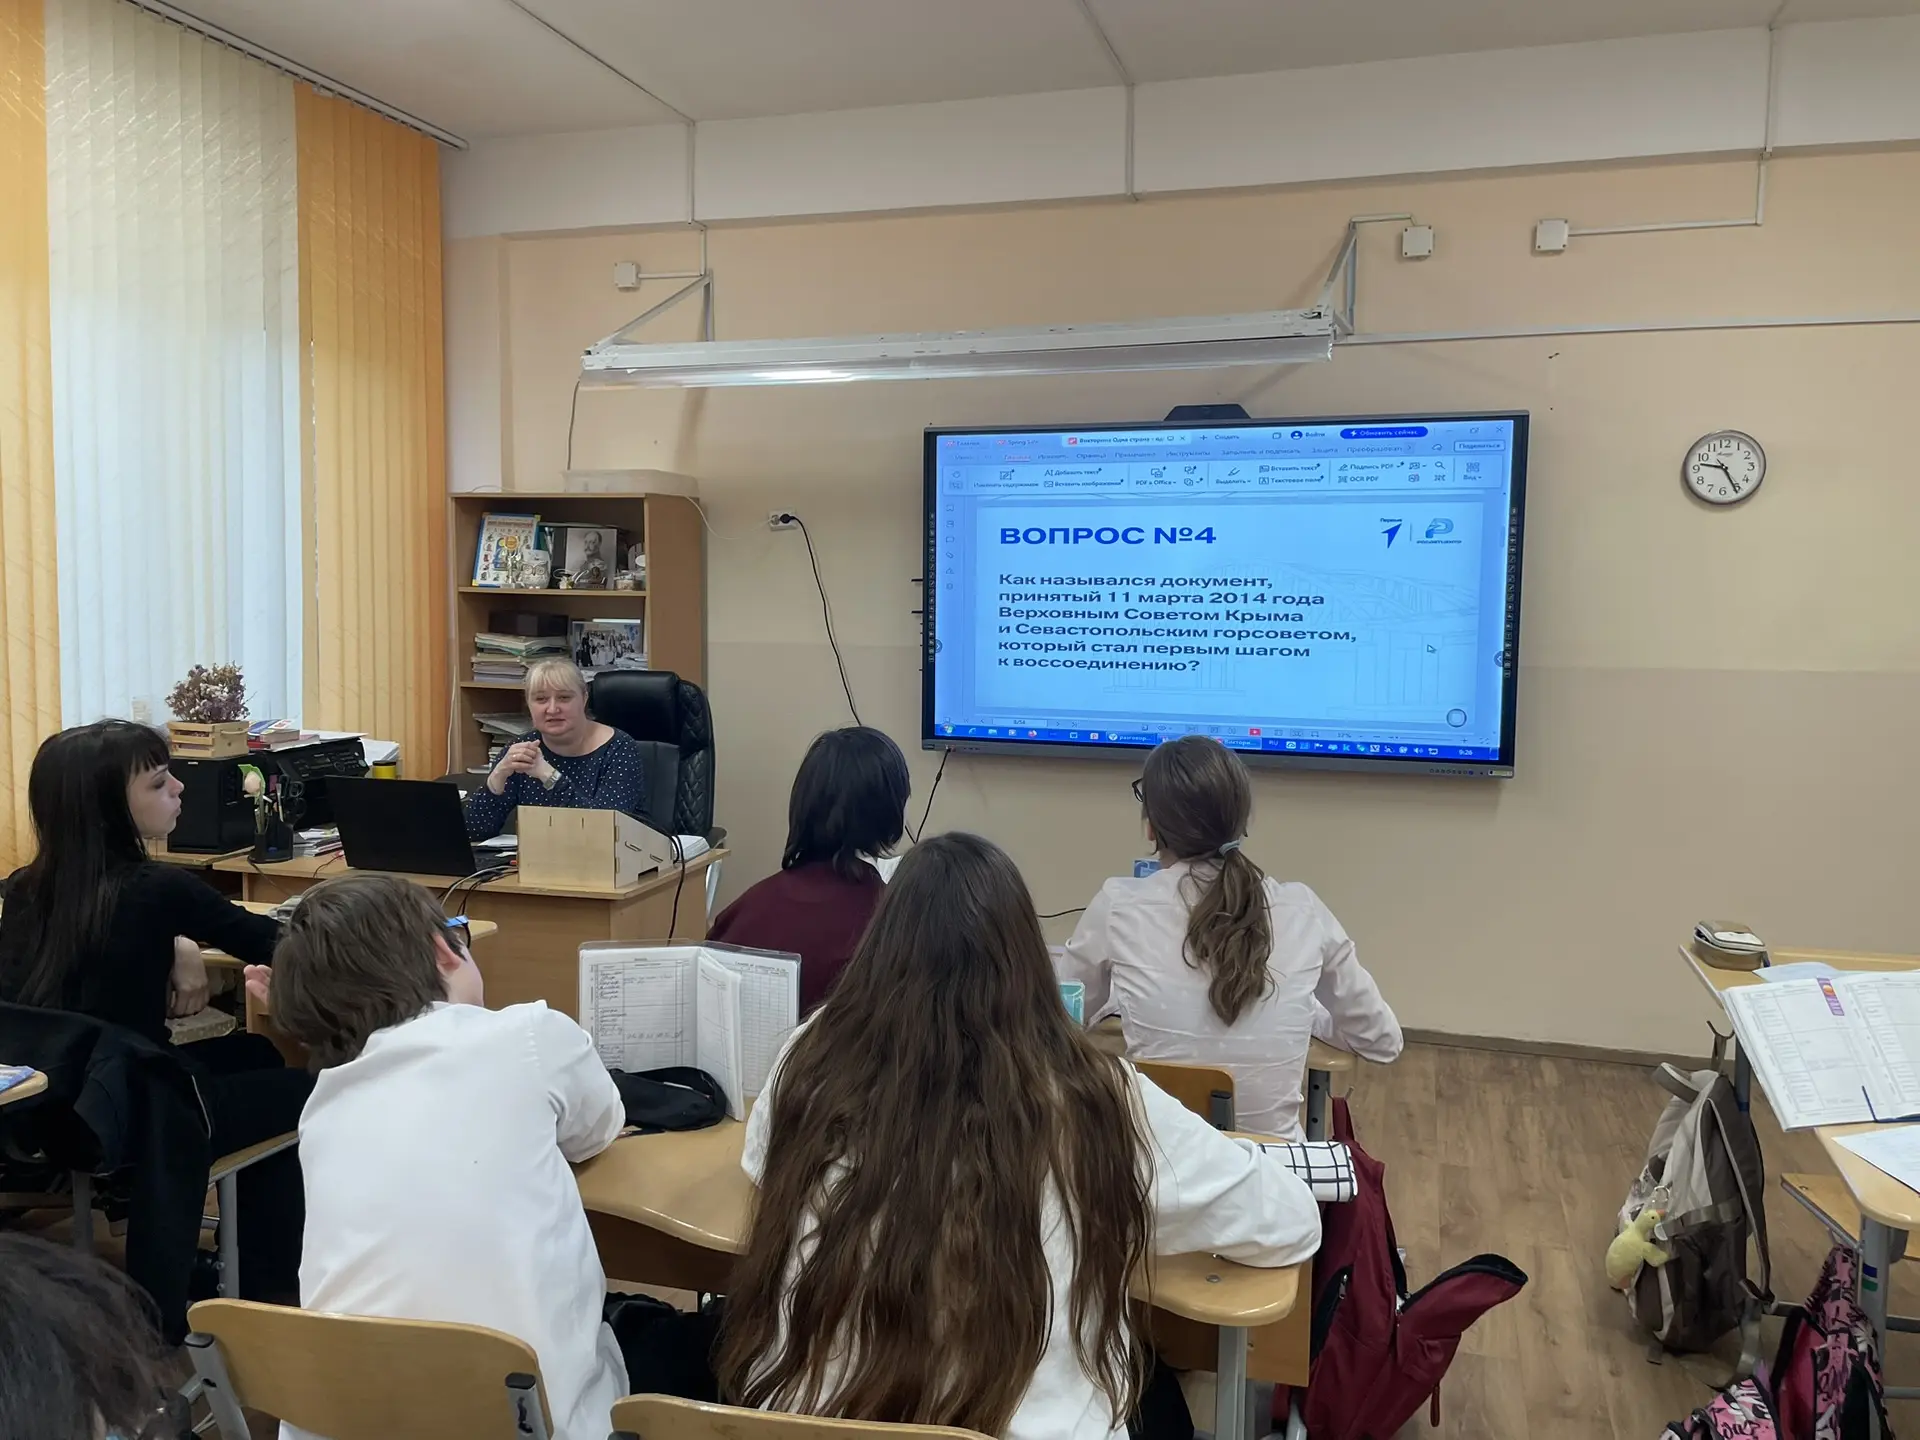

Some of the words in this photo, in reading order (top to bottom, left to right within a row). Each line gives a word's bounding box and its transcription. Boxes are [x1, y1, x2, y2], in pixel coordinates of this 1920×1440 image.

[1708, 443, 1716, 452] 11
[1719, 439, 1731, 448] 12
[1698, 453, 1709, 462] 10
[1744, 450, 1751, 460] 2
[1692, 464, 1700, 473] 9
[1747, 462, 1755, 471] 3
[1697, 476, 1704, 485] 8
[1742, 474, 1749, 483] 4
[1707, 484, 1714, 493] 7
[1719, 487, 1727, 496] 6
[1000, 526, 1145, 544] ВОПРОС
[1154, 526, 1217, 544] №4
[999, 574, 1036, 586] Как
[1040, 577, 1156, 586] назывался
[1160, 577, 1273, 589] документ,
[999, 590, 1101, 602] принятый
[1108, 592, 1130, 602] 11
[1138, 594, 1204, 605] марта
[1209, 592, 1267, 604] 2014
[1272, 595, 1325, 606] года
[999, 606, 1119, 620] Верховным
[1124, 608, 1220, 621] Советом
[1225, 609, 1304, 623] Крыма
[999, 625, 1010, 634] и
[1015, 623, 1208, 637] Севастопольским
[1213, 628, 1357, 643] горсоветом,
[999, 641, 1086, 653] который
[1090, 643, 1138, 653] стал
[1143, 645, 1230, 656] первым
[1235, 646, 1311, 657] шагом
[998, 658, 1009, 666] к
[1013, 658, 1201, 671] воссоединению?
